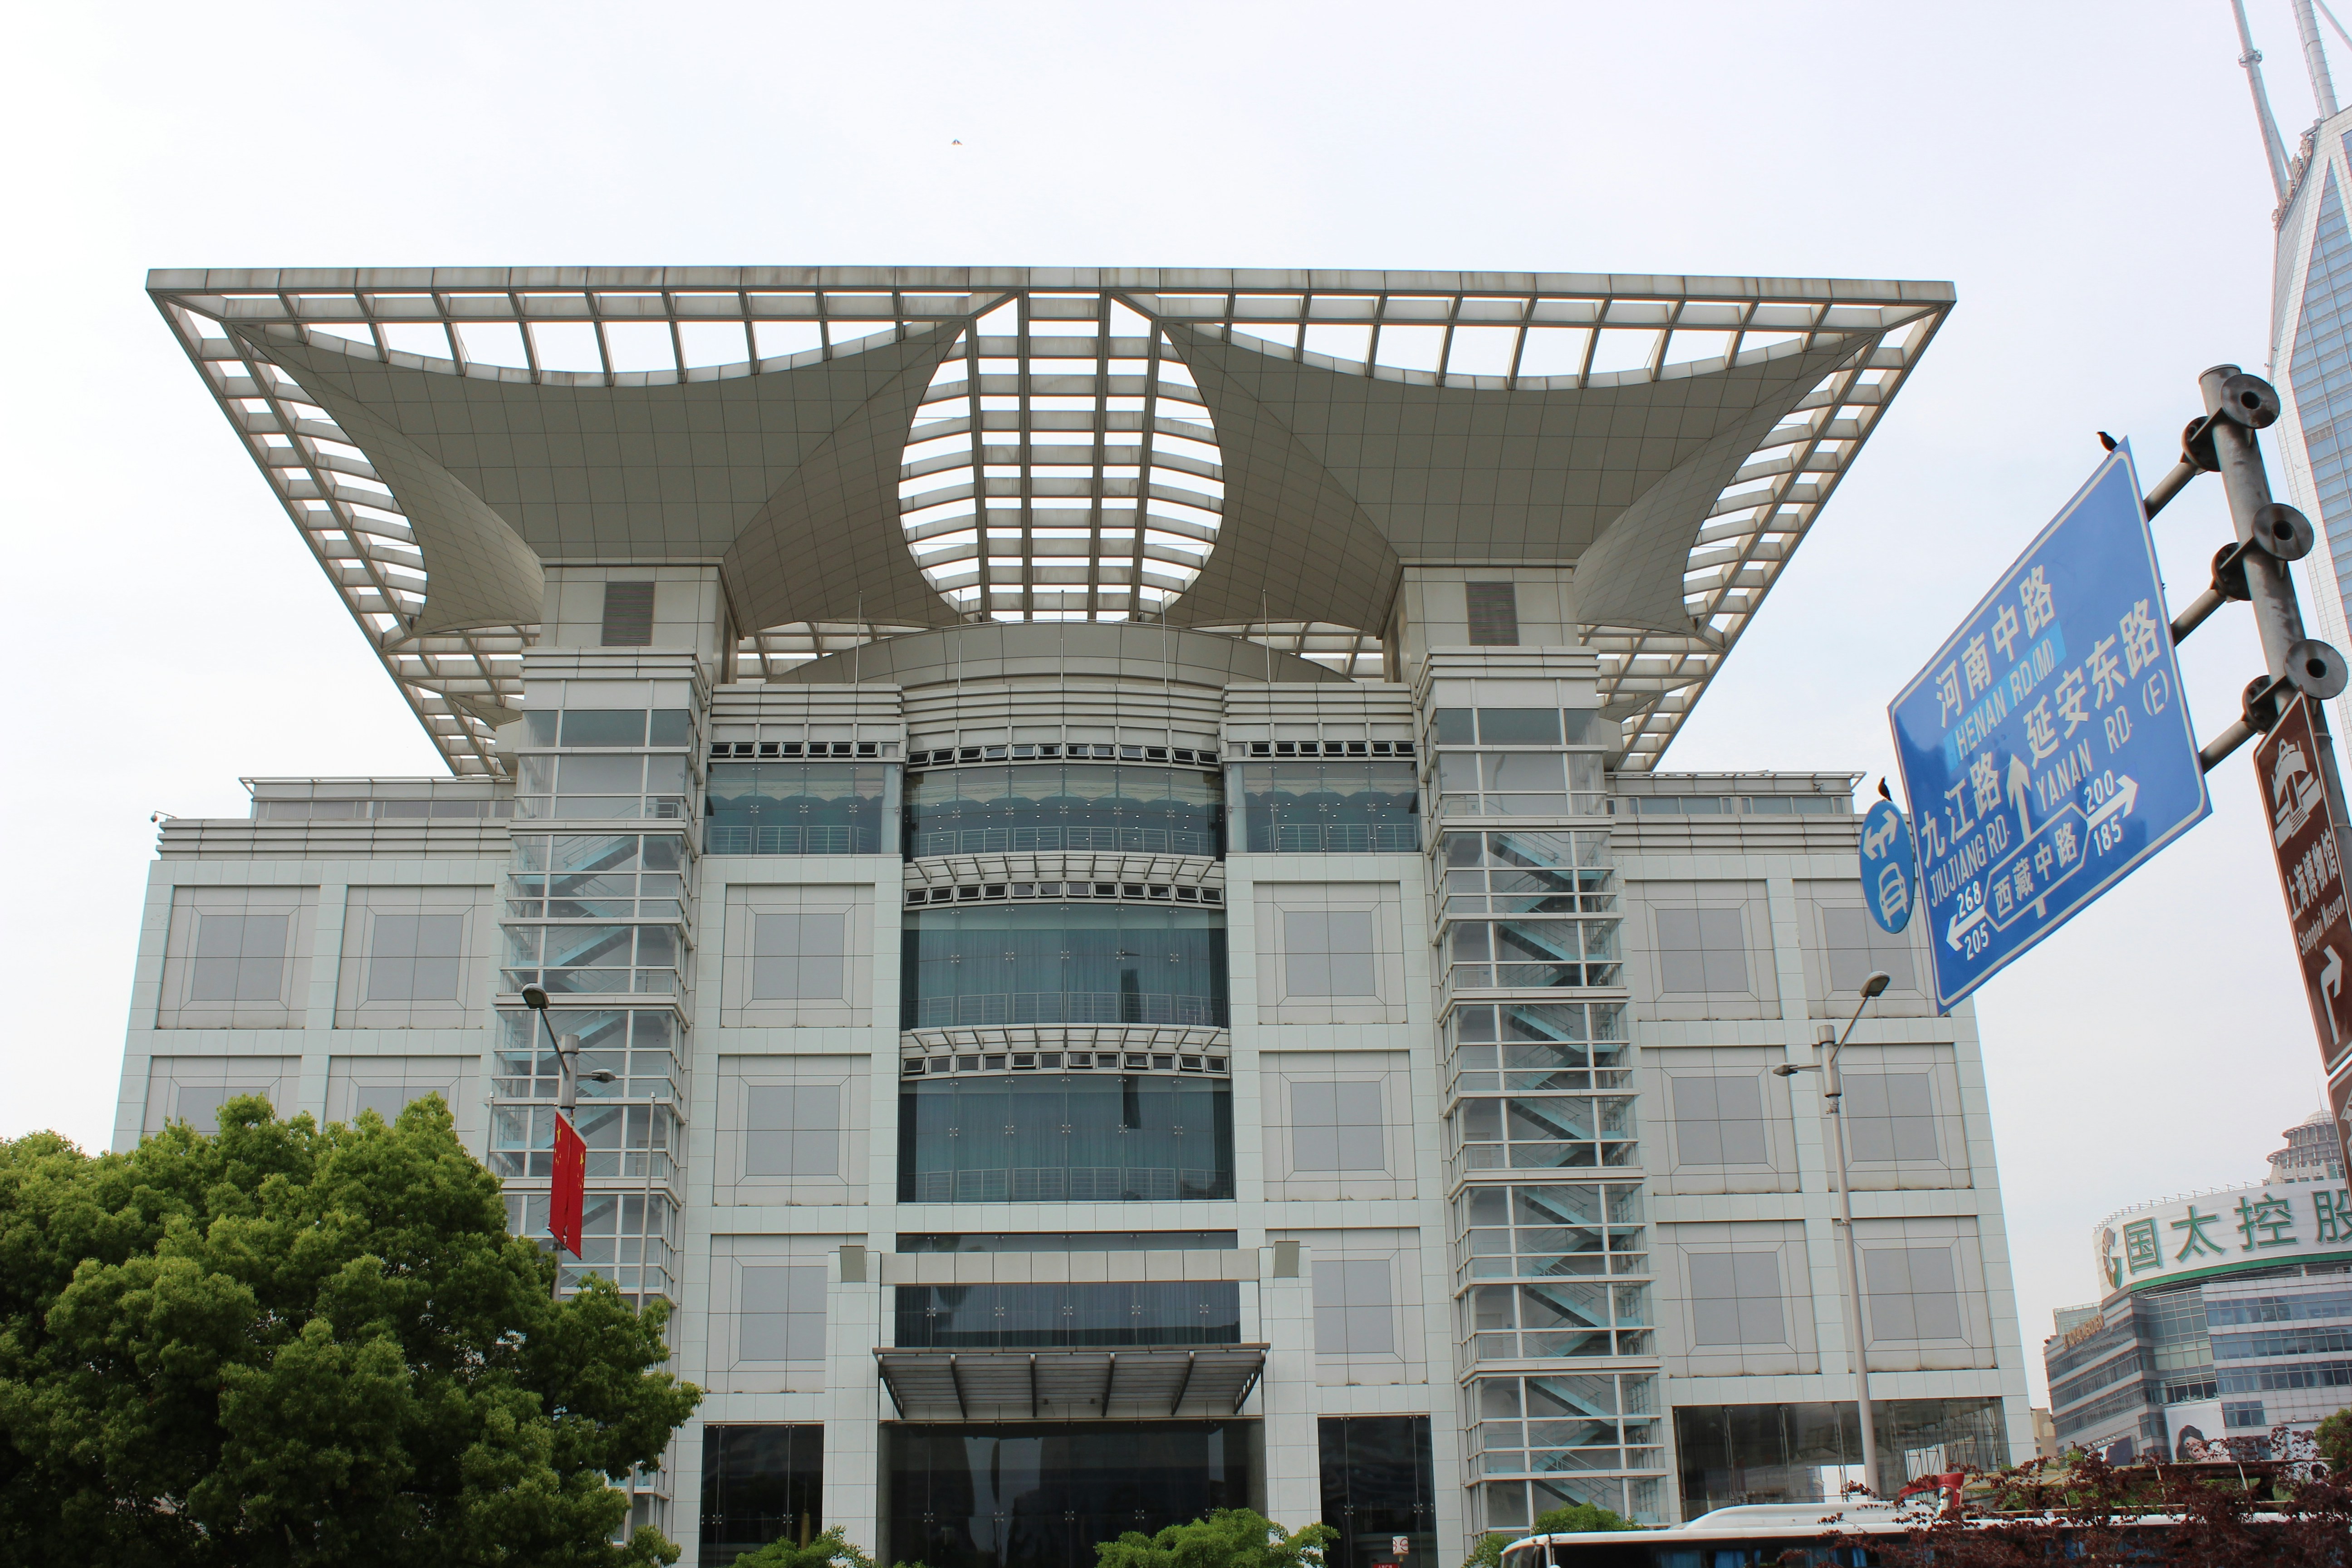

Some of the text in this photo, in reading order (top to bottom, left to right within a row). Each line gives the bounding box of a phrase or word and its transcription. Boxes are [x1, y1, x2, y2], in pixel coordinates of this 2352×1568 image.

[1936, 564, 2055, 728] 河南中路
[2023, 598, 2161, 770] 延安东路
[1955, 686, 2008, 761] HENAN
[2035, 669, 2169, 811] YANAN RD. (E)
[1920, 751, 2002, 869] 九江路
[2083, 769, 2115, 814] 200
[2093, 814, 2122, 857] 185
[1930, 814, 2010, 907] JIUJIANG RD.
[1956, 880, 1981, 919] 268
[1993, 822, 2078, 919] 西藏中路
[2286, 827, 2338, 921] 上海博物馆
[1964, 922, 1989, 961] 205
[2298, 894, 2345, 956] Shanghai Museum
[2122, 1187, 2352, 1274] 国太控股
